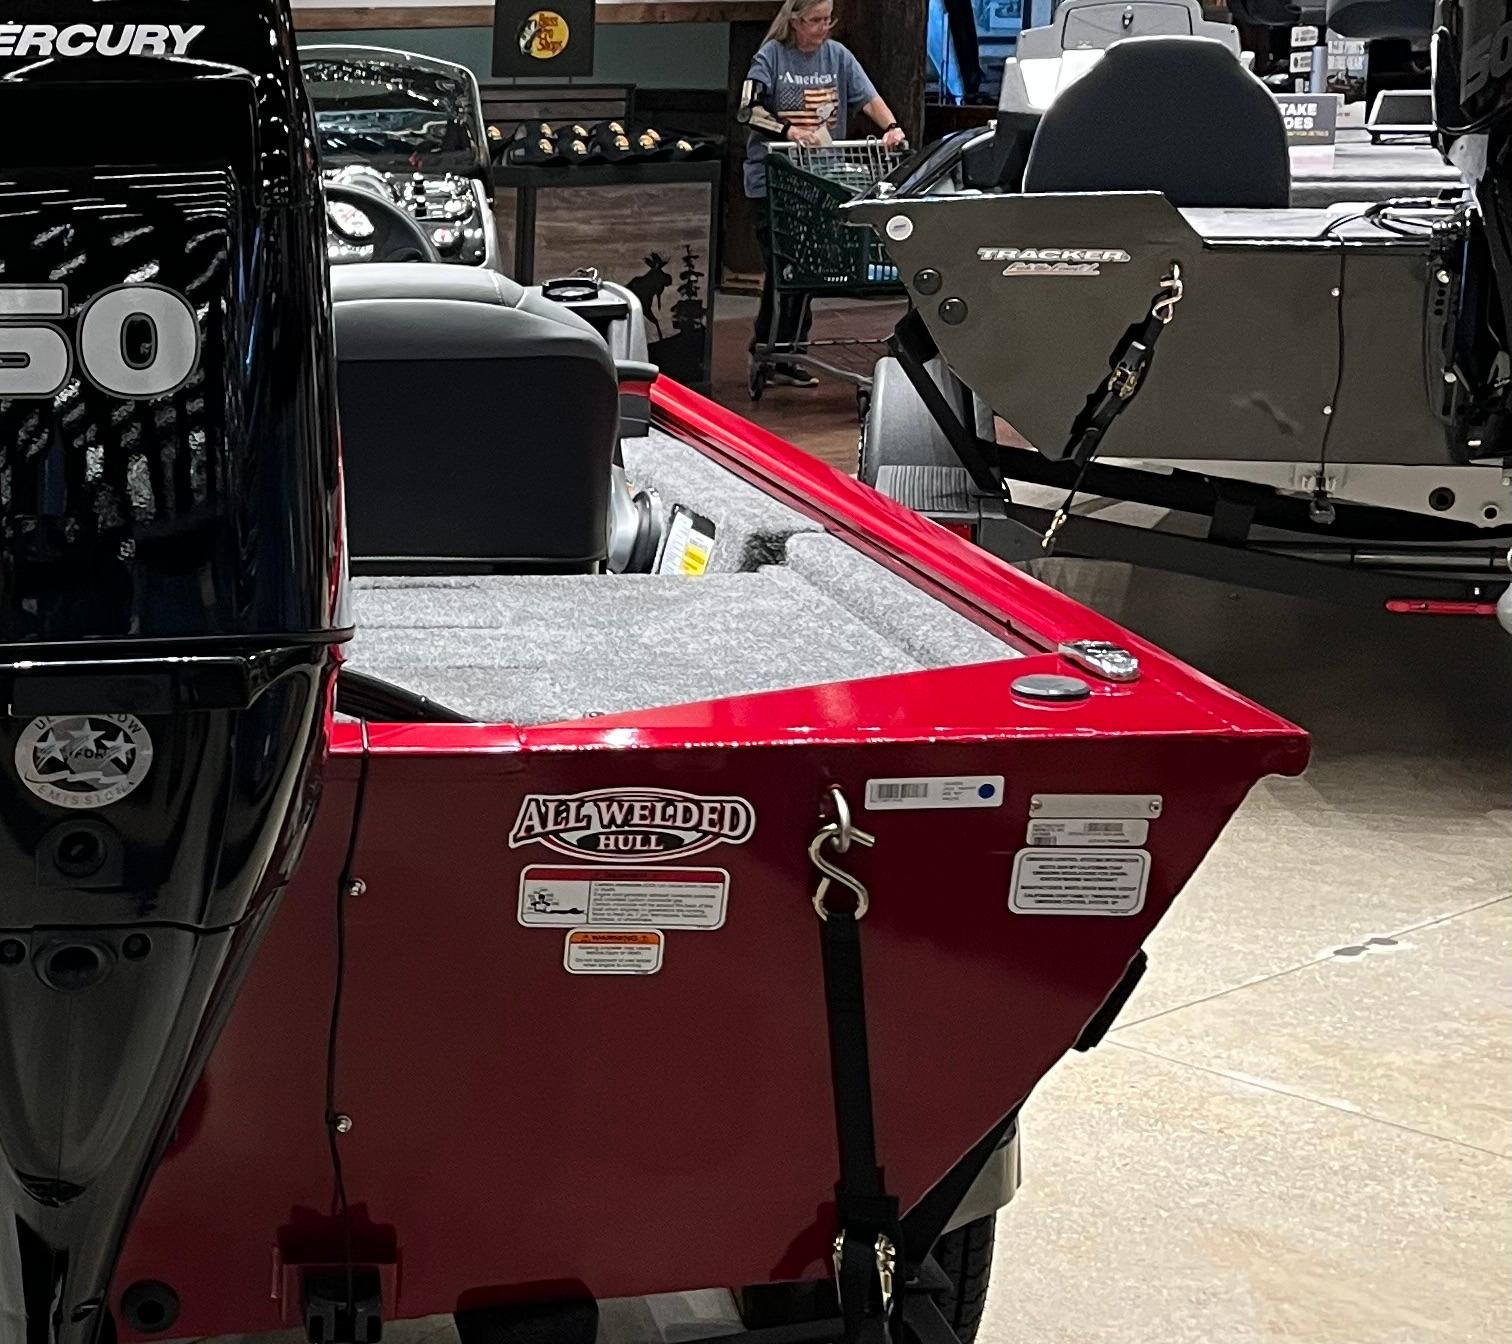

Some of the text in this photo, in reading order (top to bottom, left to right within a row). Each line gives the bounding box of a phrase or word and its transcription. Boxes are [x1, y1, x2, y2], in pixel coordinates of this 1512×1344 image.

[783, 71, 834, 85] America
[977, 247, 1125, 262] TRACKER
[517, 798, 747, 838] ALL WELDED
[597, 834, 664, 851] HULL
